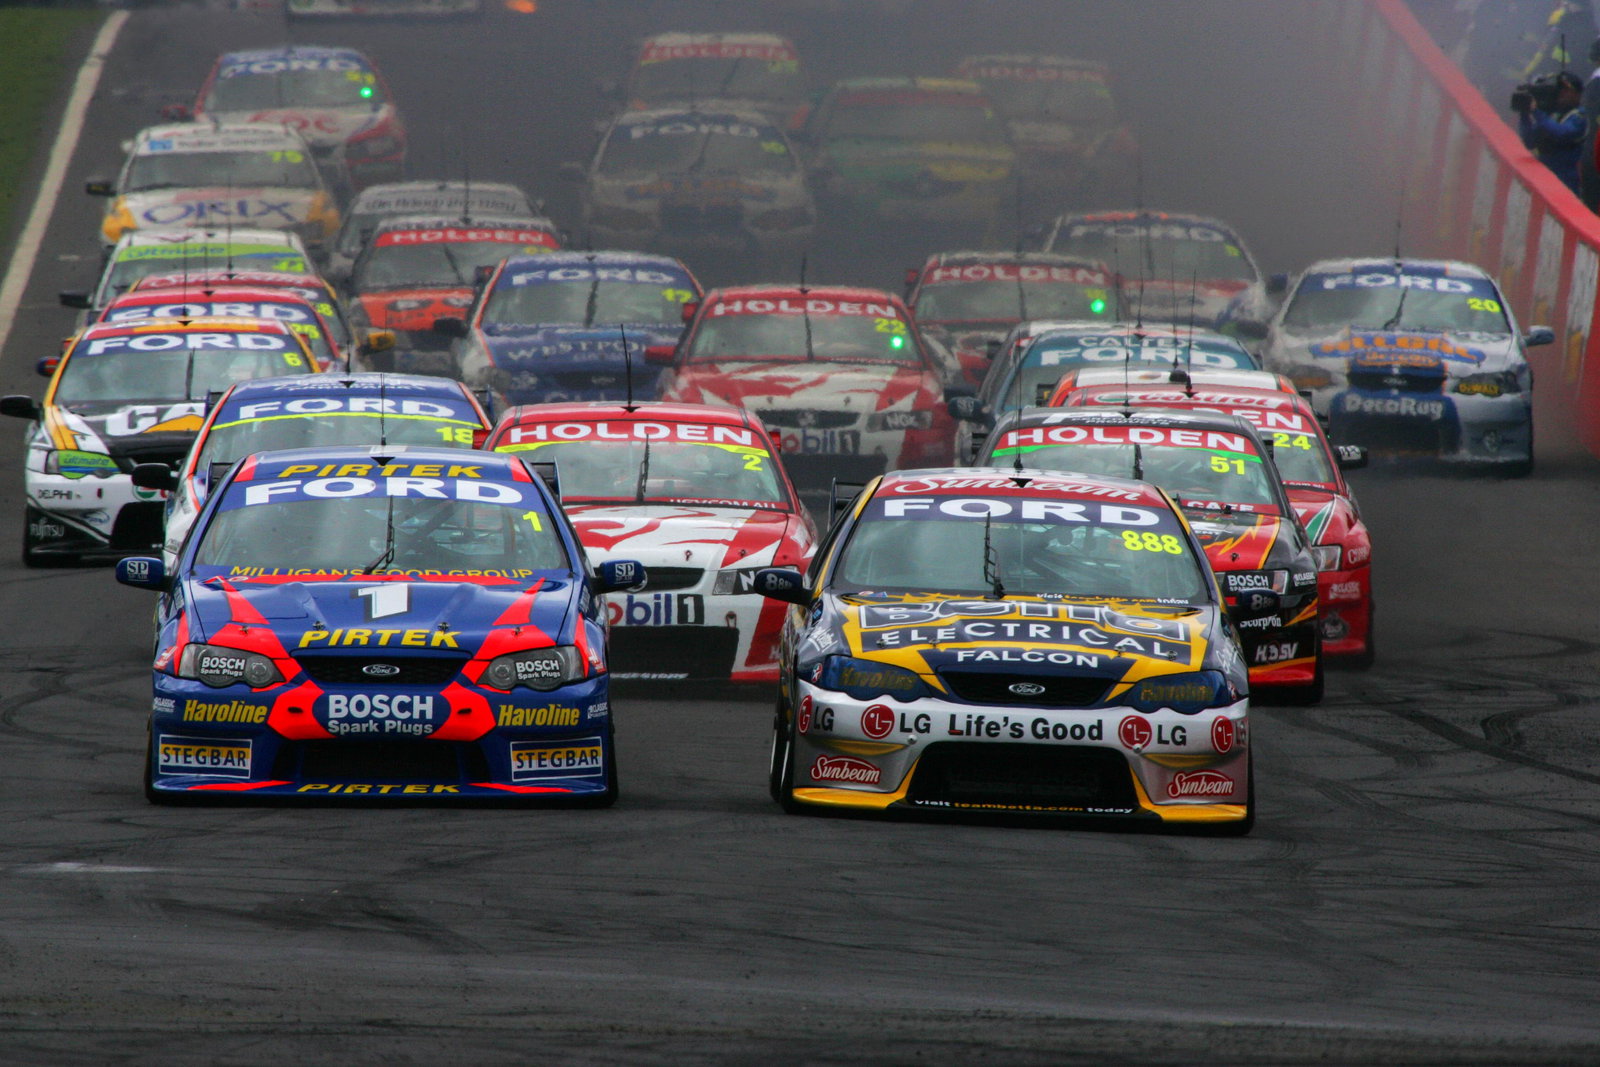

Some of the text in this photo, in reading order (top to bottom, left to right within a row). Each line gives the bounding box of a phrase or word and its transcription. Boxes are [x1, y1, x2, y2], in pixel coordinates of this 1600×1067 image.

[143, 200, 297, 224] ORIX
[392, 231, 543, 243] HOLDEN
[512, 268, 675, 286] FORD
[933, 265, 1104, 283] HOLDEN
[1323, 274, 1473, 293] FORD
[714, 300, 896, 318] HOLDEN
[1467, 297, 1500, 312] 20
[874, 318, 906, 334] 22
[87, 334, 285, 355] FORD
[508, 341, 646, 360] WESTPO
[283, 352, 302, 366] 6
[1040, 346, 1237, 370] FORD
[239, 398, 456, 420] FORD
[1345, 393, 1443, 420] DecoRug
[436, 426, 473, 444] 18
[511, 423, 752, 445] HOLDEN
[1007, 427, 1246, 451] HOLDEN
[1272, 433, 1311, 450] 24
[277, 464, 484, 479] PIRTEK
[743, 454, 763, 471] 2
[1210, 456, 1245, 475] 51
[38, 489, 72, 500] DELPHI
[246, 477, 523, 506] FORD
[523, 511, 542, 532] 1
[884, 498, 1160, 526] FORD
[30, 517, 65, 539] FUJITSU
[1121, 530, 1182, 555] 888
[127, 560, 149, 575] SP
[615, 562, 635, 577] SP
[1227, 575, 1269, 587] BOSCH
[358, 583, 408, 619] 1
[298, 629, 461, 647] PIRTEK
[881, 622, 1170, 658] ELECTRICAL
[201, 657, 245, 670] BOSCH
[516, 659, 560, 673] BOSCH
[957, 650, 1098, 668] FALCON
[200, 667, 243, 678] Spark Plugs
[517, 670, 561, 680] Spark Plugs
[183, 699, 268, 724] Havoline
[328, 694, 434, 720] BOSCH
[498, 704, 580, 727] Havoline
[328, 720, 434, 735] Spark Plugs
[813, 706, 834, 731] LG
[900, 713, 1103, 741] LG Life's Good
[1157, 724, 1187, 746] LG
[162, 746, 247, 768] STEGBAR
[516, 748, 599, 769] STEGBAR
[811, 756, 881, 783] Sunbeam
[297, 784, 461, 794] PIRTEK
[1168, 772, 1234, 797] Sunbeam
[915, 799, 950, 807] visit
[1087, 806, 1134, 814] today
